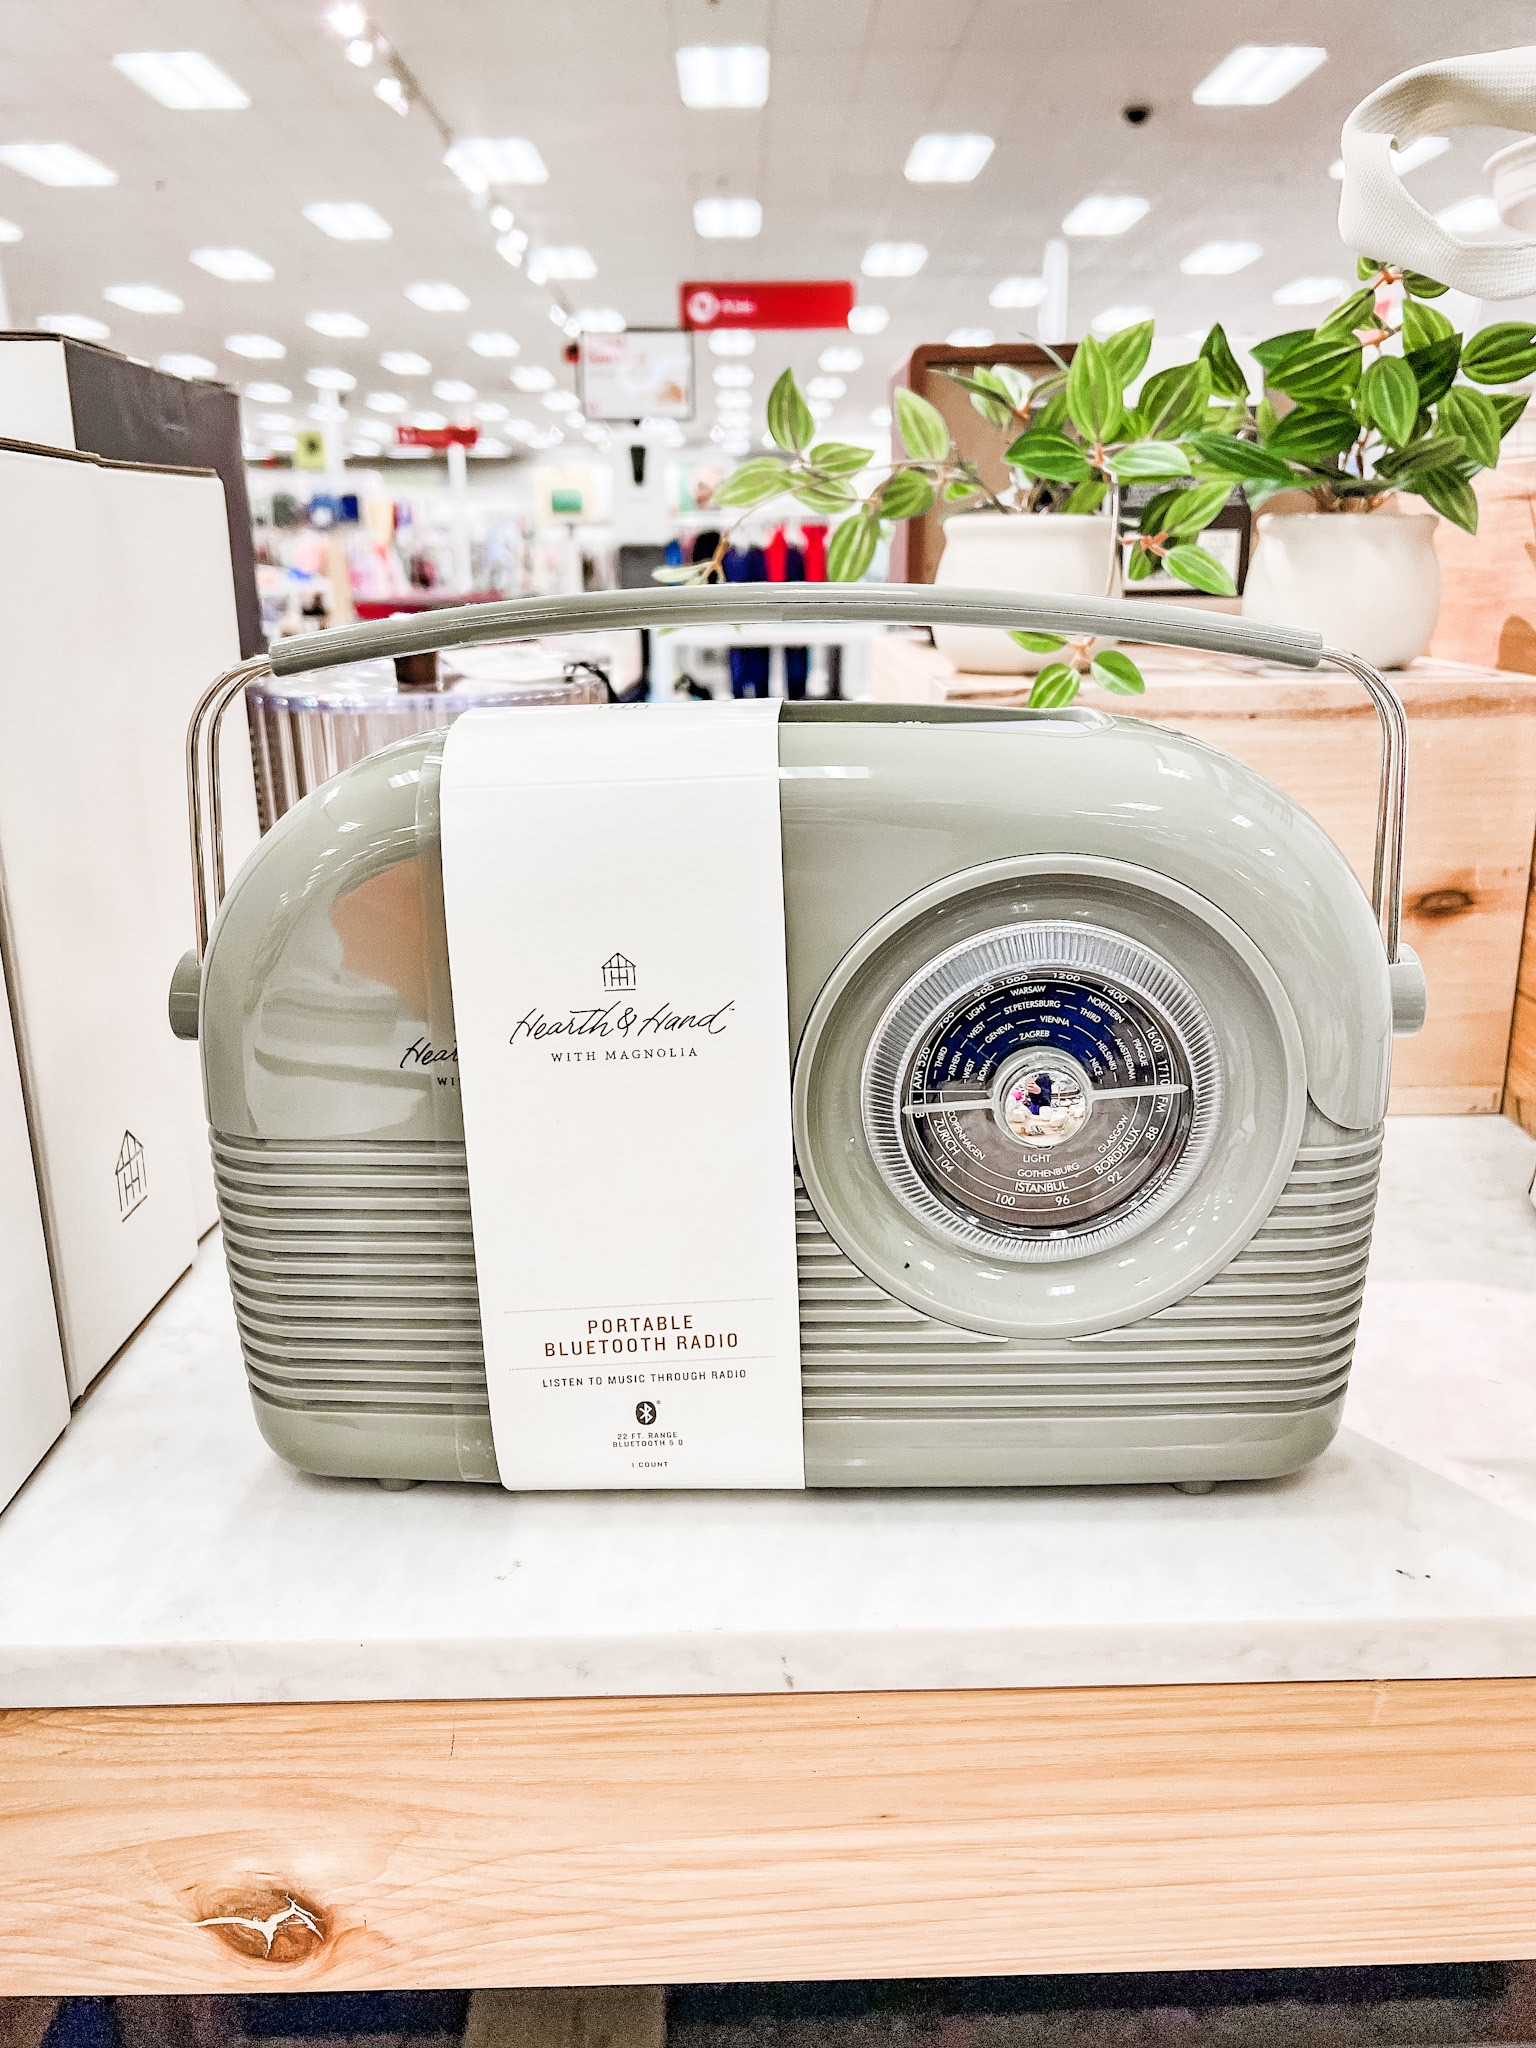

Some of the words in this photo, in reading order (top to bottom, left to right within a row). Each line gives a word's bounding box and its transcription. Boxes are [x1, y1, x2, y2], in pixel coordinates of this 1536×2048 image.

[509, 1000, 621, 1045] Hearth
[617, 1006, 638, 1038] &
[934, 1046, 948, 1068] THIRD
[965, 1002, 987, 1021] LIGHT
[1010, 985, 1046, 997] WARSAW
[1087, 995, 1125, 1024] NORTHERN
[1132, 1038, 1149, 1067] PRAGUE
[938, 1011, 955, 1029] 700
[973, 984, 995, 998] 900
[1000, 974, 1029, 986] 1000
[1052, 972, 1081, 982] 1200
[1101, 985, 1128, 1004] 1400
[1144, 1025, 1165, 1053] 1600
[1156, 1059, 1171, 1085] 1710
[551, 1050, 597, 1062] WITH
[604, 1047, 699, 1061] MAGNOLIA
[949, 1051, 963, 1077] ATHEN
[967, 1021, 986, 1039] WEST
[1080, 1007, 1102, 1024] THIRD
[1114, 1038, 1137, 1080] AMSTERDAM
[962, 1058, 976, 1079] WEST
[984, 1022, 1015, 1044] GENEVA
[1039, 1015, 1070, 1027] VIENNA
[1096, 1040, 1117, 1071] HELSINKI
[916, 1047, 931, 1067] 520
[976, 1059, 993, 1083] ROMA
[1018, 1030, 1050, 1041] ZAGREB
[1089, 1057, 1104, 1077] NICE
[436, 1076, 461, 1087] WI
[912, 1070, 924, 1090] AM
[1155, 1096, 1169, 1113] FM
[947, 1110, 986, 1160] COPENHAGEN
[1017, 1162, 1080, 1178] GOTHENBURG
[1097, 1114, 1129, 1154] GLASGOW
[933, 1118, 961, 1156] ZURICH
[1014, 1180, 1069, 1193] ISTANBUL
[1094, 1126, 1142, 1175] BORDEAUX
[935, 1153, 955, 1173] 104
[995, 1193, 1016, 1206] 100
[1055, 1195, 1070, 1206] 96
[1107, 1171, 1123, 1185] 92
[1145, 1126, 1159, 1141] 88
[1023, 1154, 1051, 1163] LIGHT
[587, 1314, 694, 1334] PORTABLE
[544, 1337, 666, 1357] BLUETOOTH
[676, 1333, 739, 1350] RADIO
[542, 1374, 583, 1388] LISTEN
[589, 1376, 603, 1386] TO
[608, 1373, 646, 1385] MUSIC
[650, 1371, 707, 1382] THROUGH
[711, 1369, 747, 1380] RADIO
[612, 1440, 666, 1448] BLUETOOTH
[648, 1431, 678, 1439] RANGE
